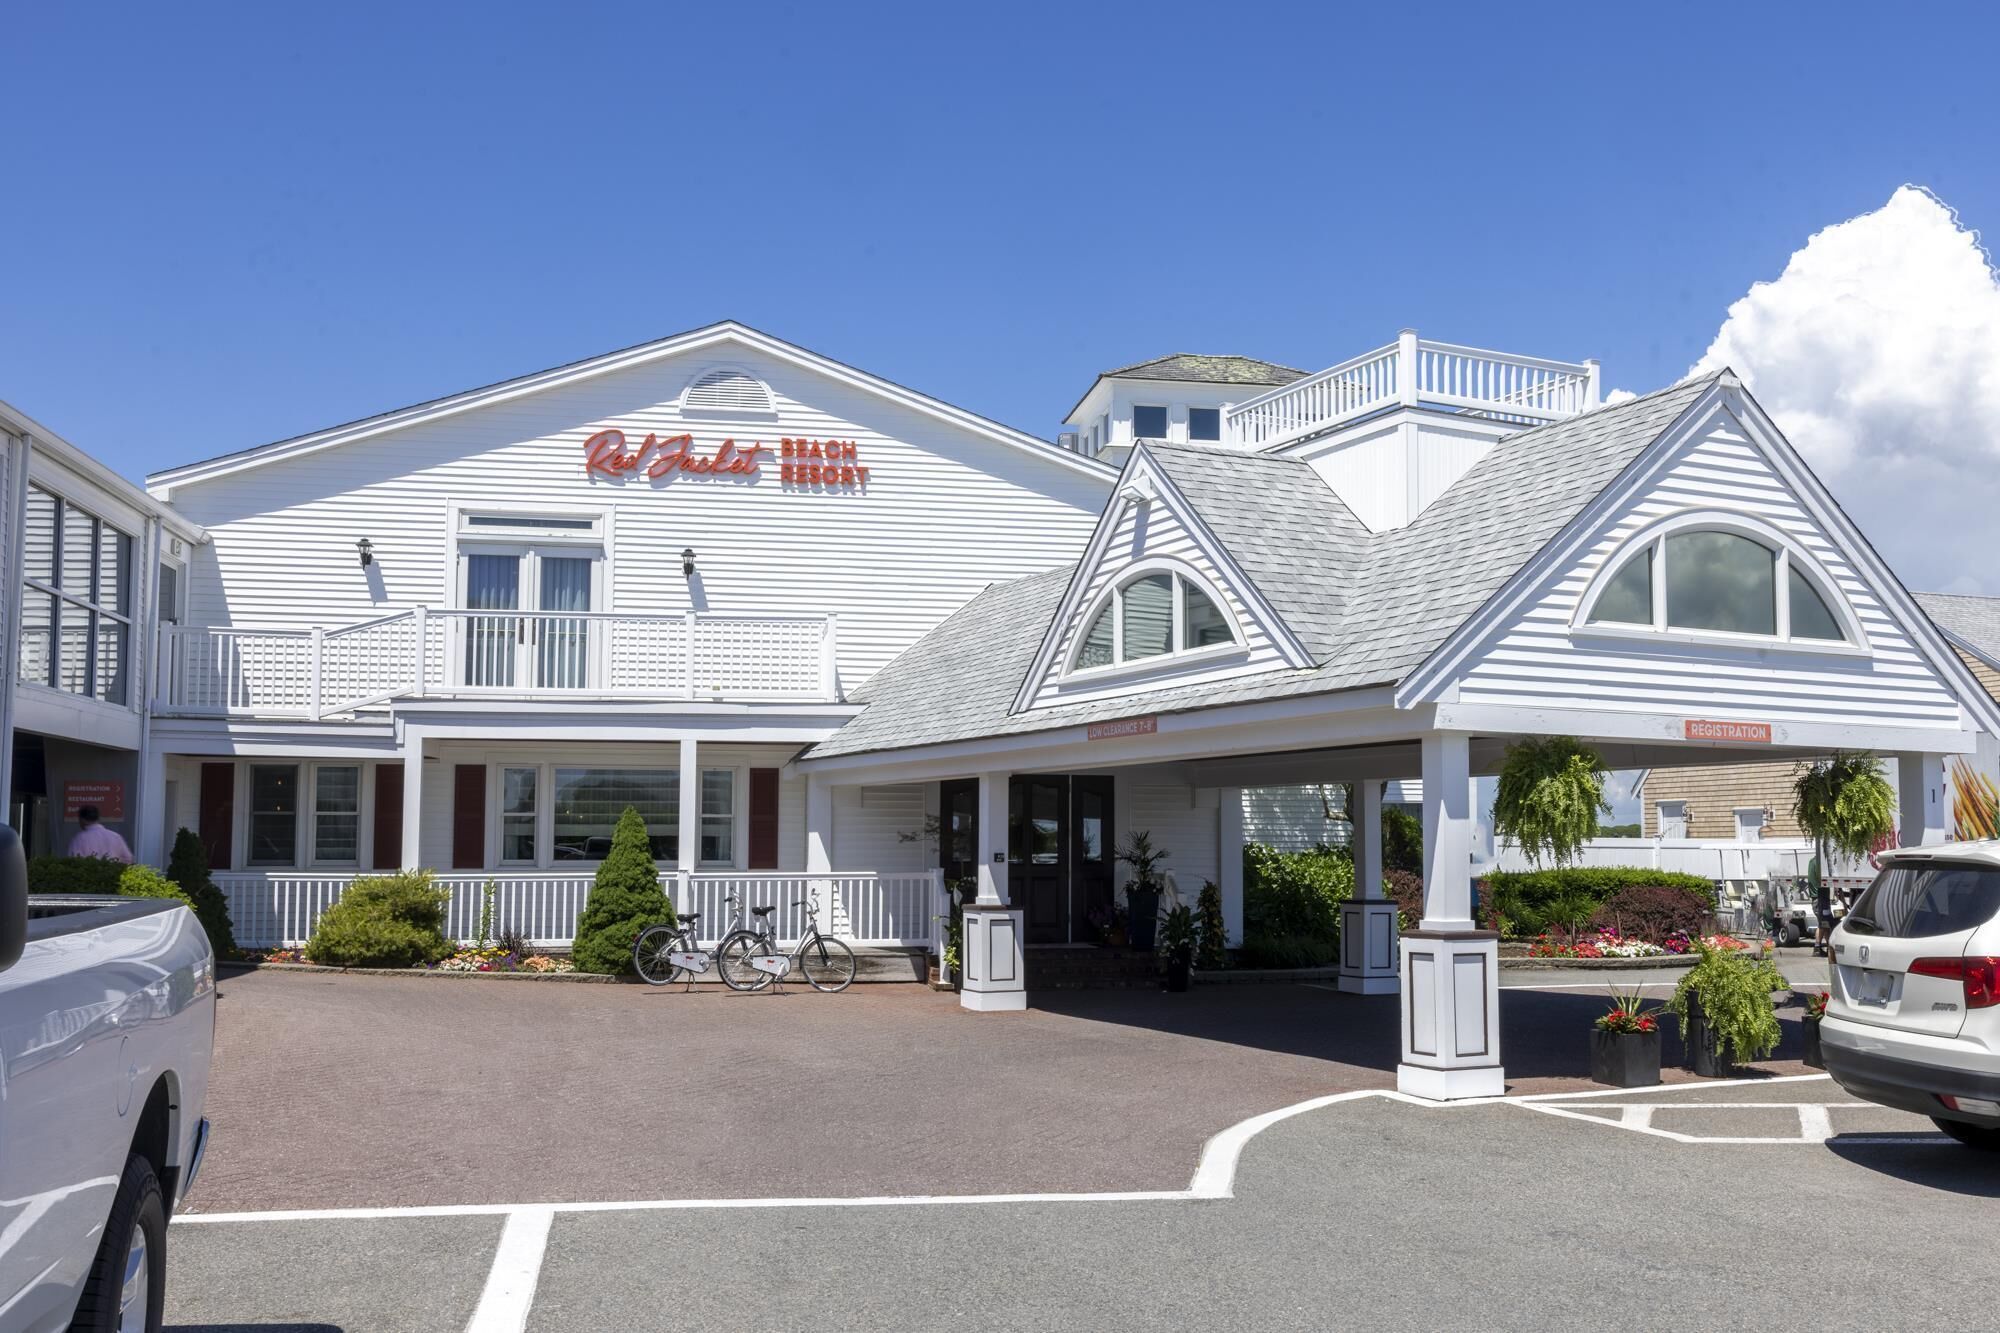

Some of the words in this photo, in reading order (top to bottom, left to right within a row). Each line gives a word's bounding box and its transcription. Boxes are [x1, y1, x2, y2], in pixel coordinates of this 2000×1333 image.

[583, 429, 655, 477] Red
[648, 433, 774, 479] Jacket
[781, 438, 856, 459] BEACH
[781, 463, 870, 485] RESORT
[1089, 727, 1102, 738] LOW
[1103, 722, 1138, 736] CLEARANCE
[1691, 723, 1766, 738] REGISTRATION
